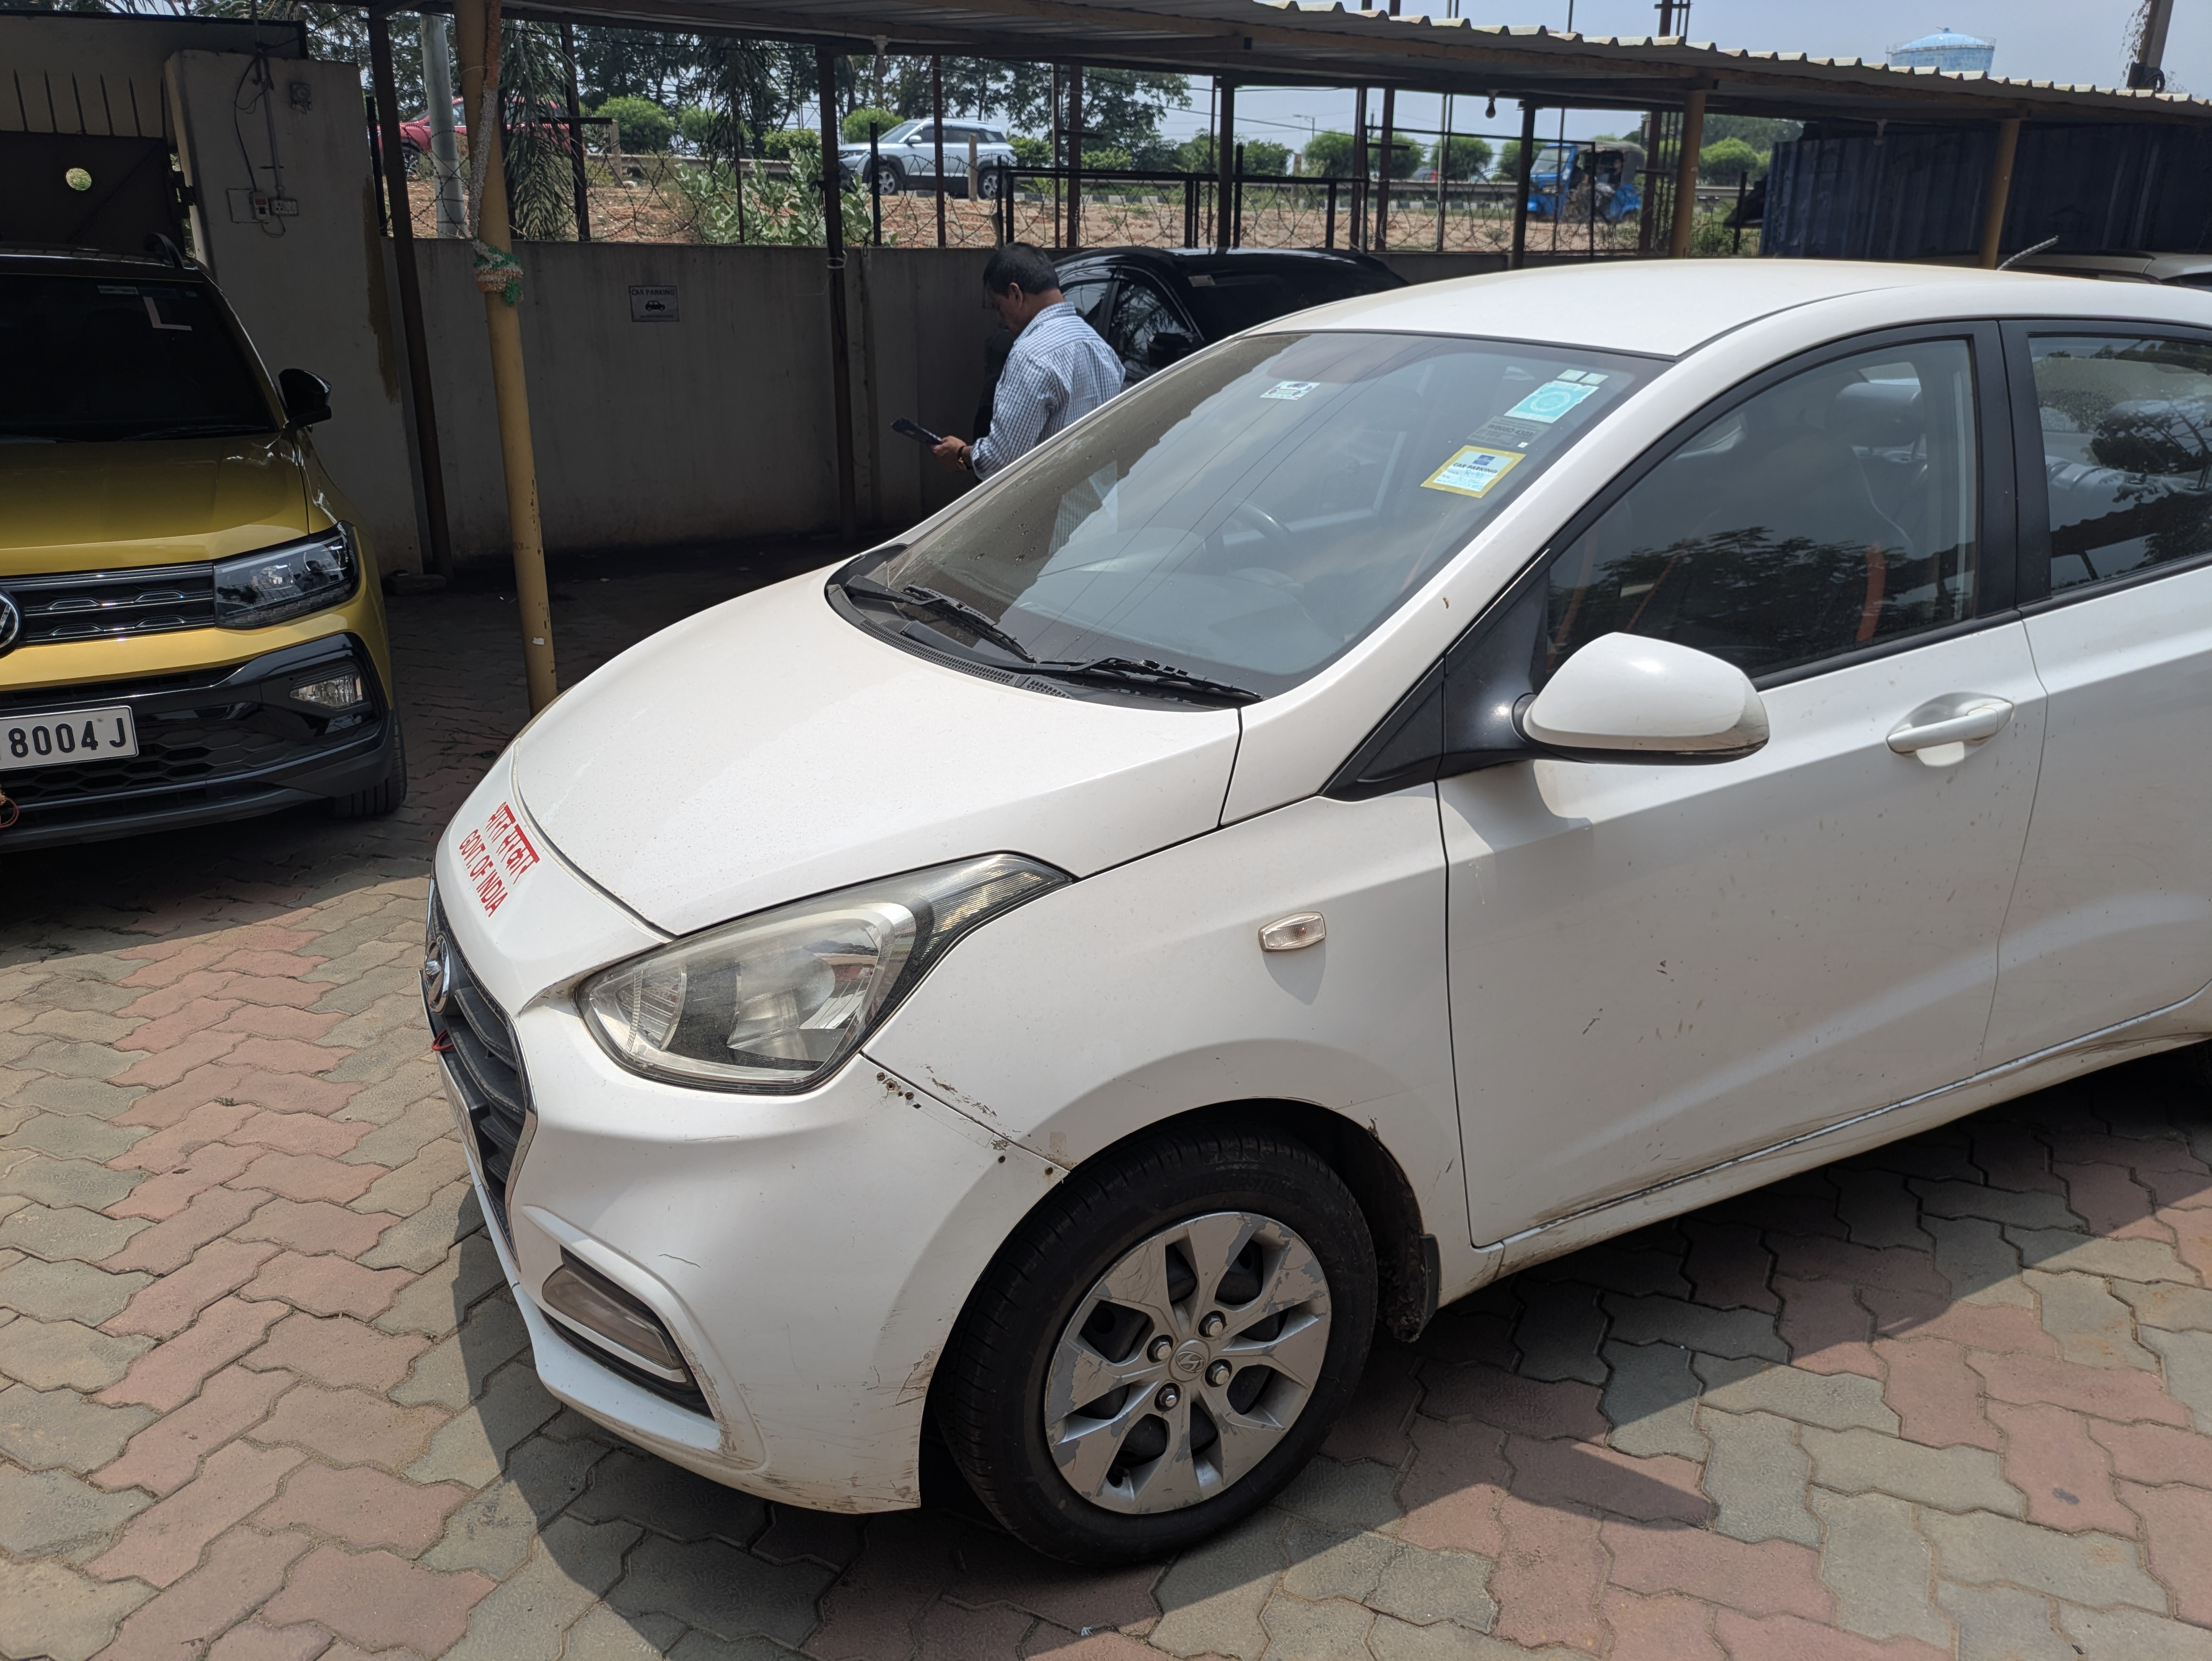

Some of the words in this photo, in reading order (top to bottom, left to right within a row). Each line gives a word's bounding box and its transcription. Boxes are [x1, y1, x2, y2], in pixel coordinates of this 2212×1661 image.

[1467, 465, 1498, 474] PARKING
[8, 720, 99, 758] 8004
[109, 717, 126, 747] J
[485, 801, 516, 844] भारत
[470, 855, 494, 881] OF
[496, 824, 540, 885] सरकार
[476, 869, 508, 918] INDIA
